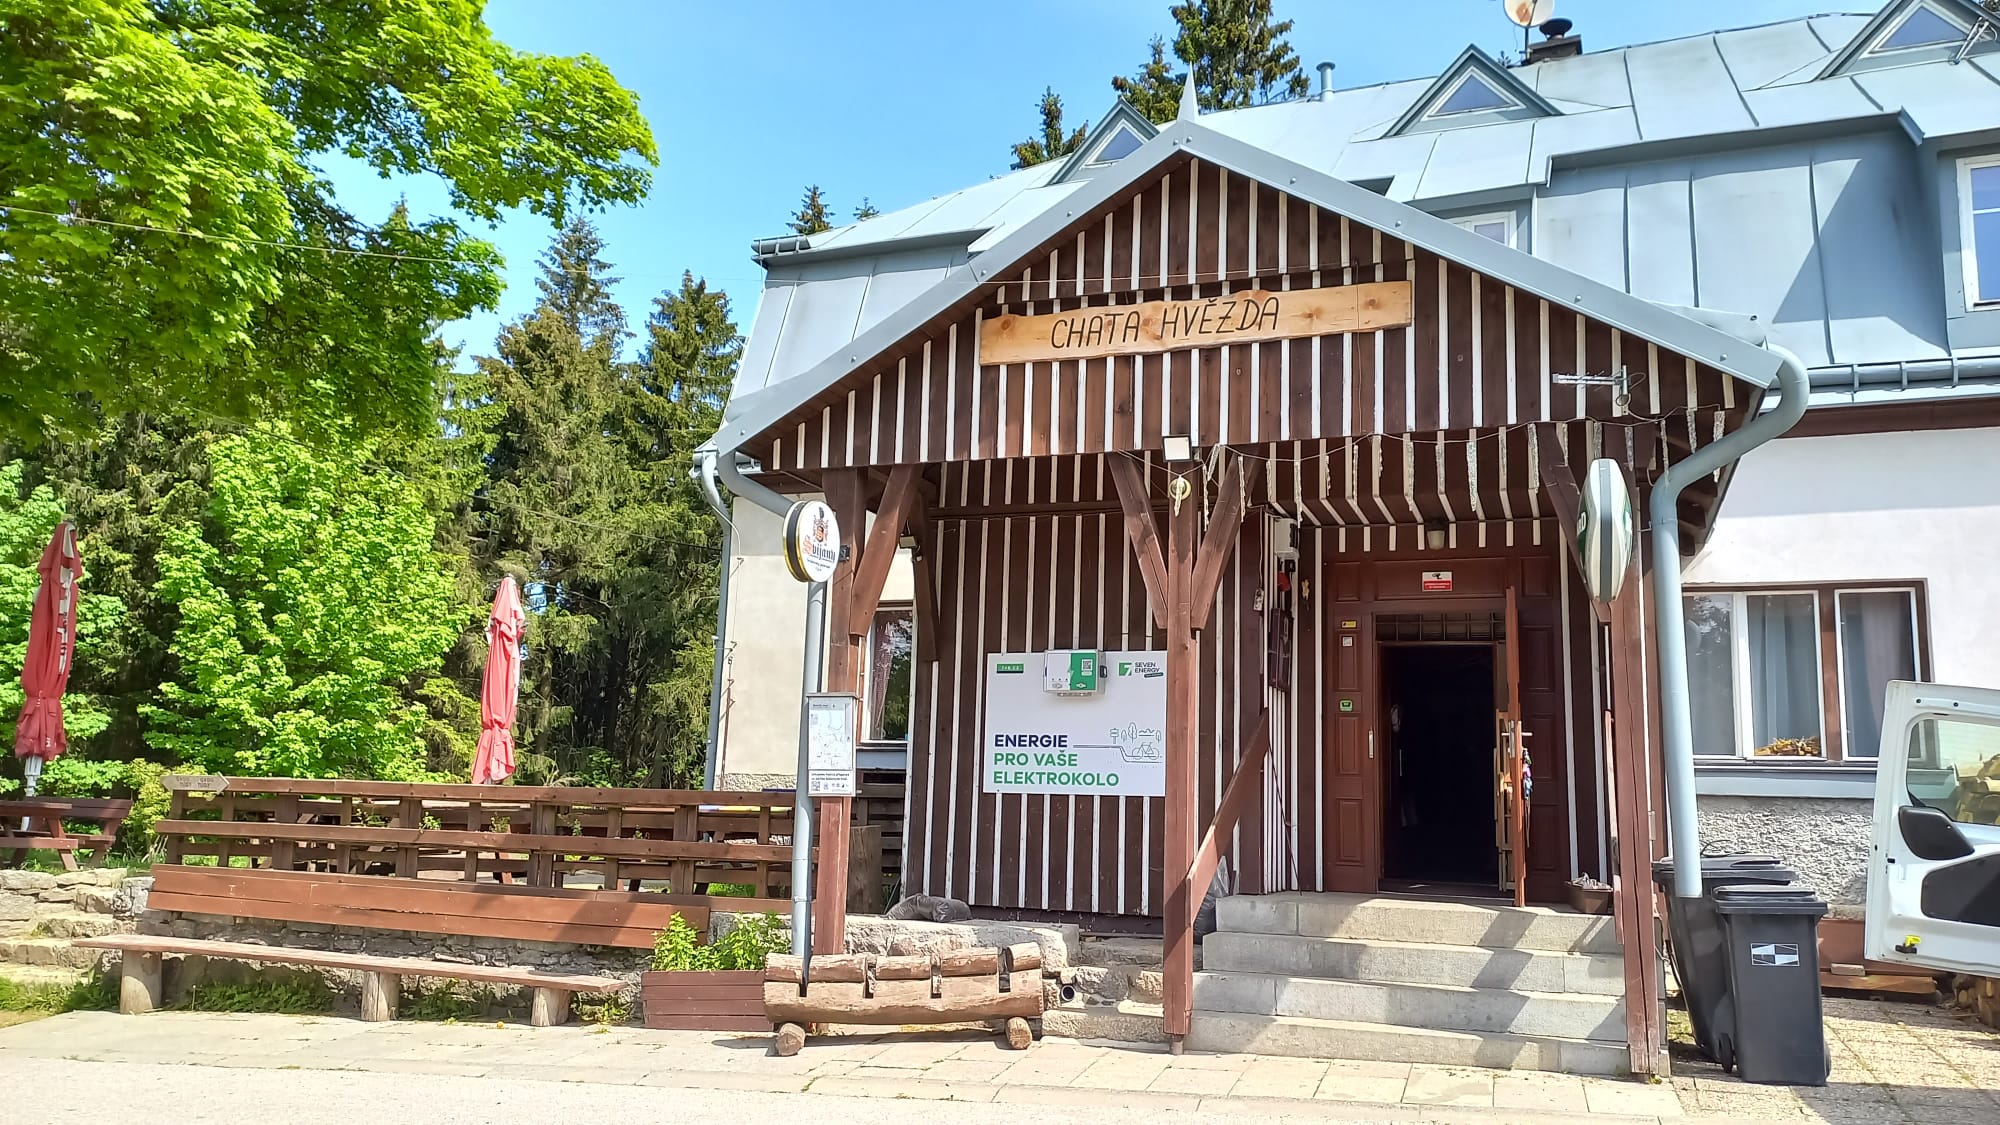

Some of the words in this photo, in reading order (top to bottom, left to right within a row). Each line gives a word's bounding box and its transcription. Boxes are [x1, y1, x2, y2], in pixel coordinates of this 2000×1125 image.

[1050, 309, 1142, 350] CHATA
[1160, 296, 1280, 339] HVĚZDA
[994, 734, 1068, 748] ENERGIE
[993, 752, 1029, 767] PRO
[1033, 749, 1078, 767] VAŠE
[993, 771, 1120, 787] ELEKTROKOLO
